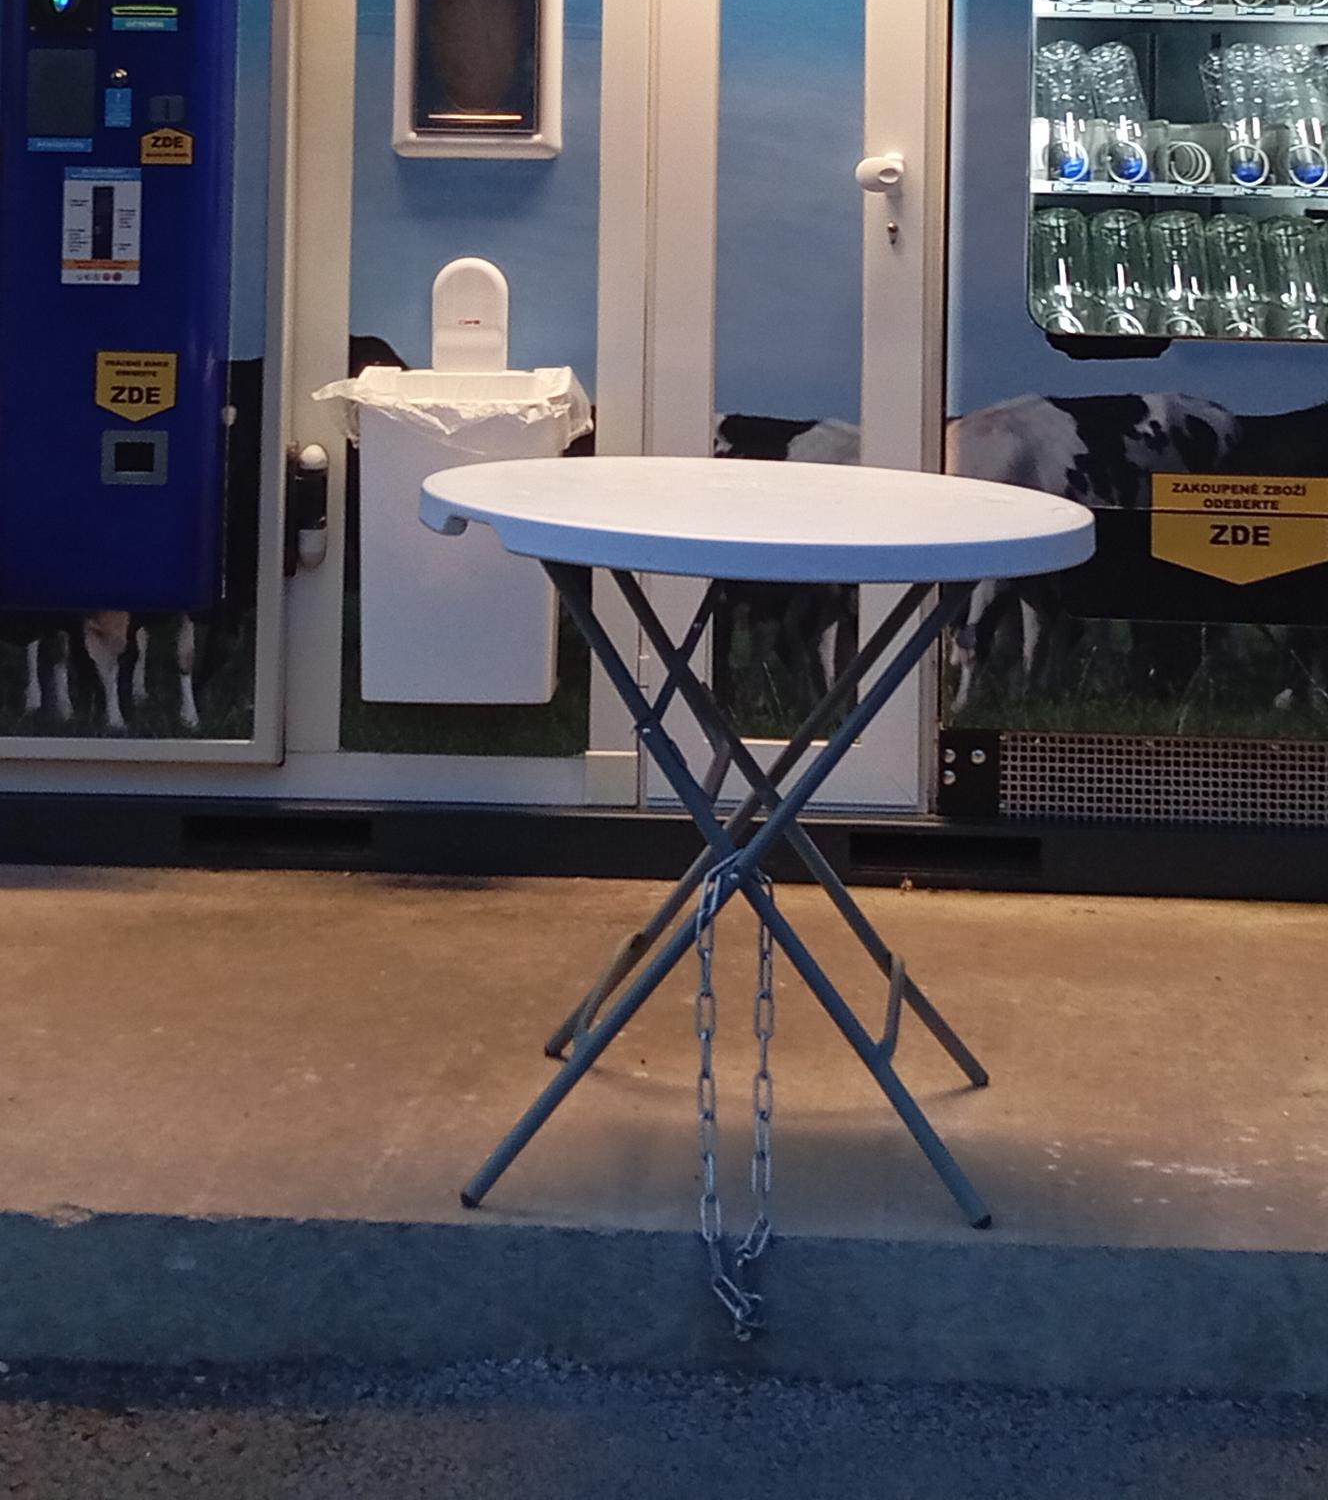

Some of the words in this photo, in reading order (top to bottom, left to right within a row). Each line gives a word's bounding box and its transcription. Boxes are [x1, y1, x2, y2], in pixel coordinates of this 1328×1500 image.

[150, 135, 184, 149] ZDE
[110, 385, 162, 405] ZDE
[1171, 482, 1259, 496] ZAKOUPENÉ
[1263, 483, 1307, 497] ZBOŽÍ
[1203, 498, 1280, 511] ODEBERTE
[1209, 524, 1271, 547] ZDE
